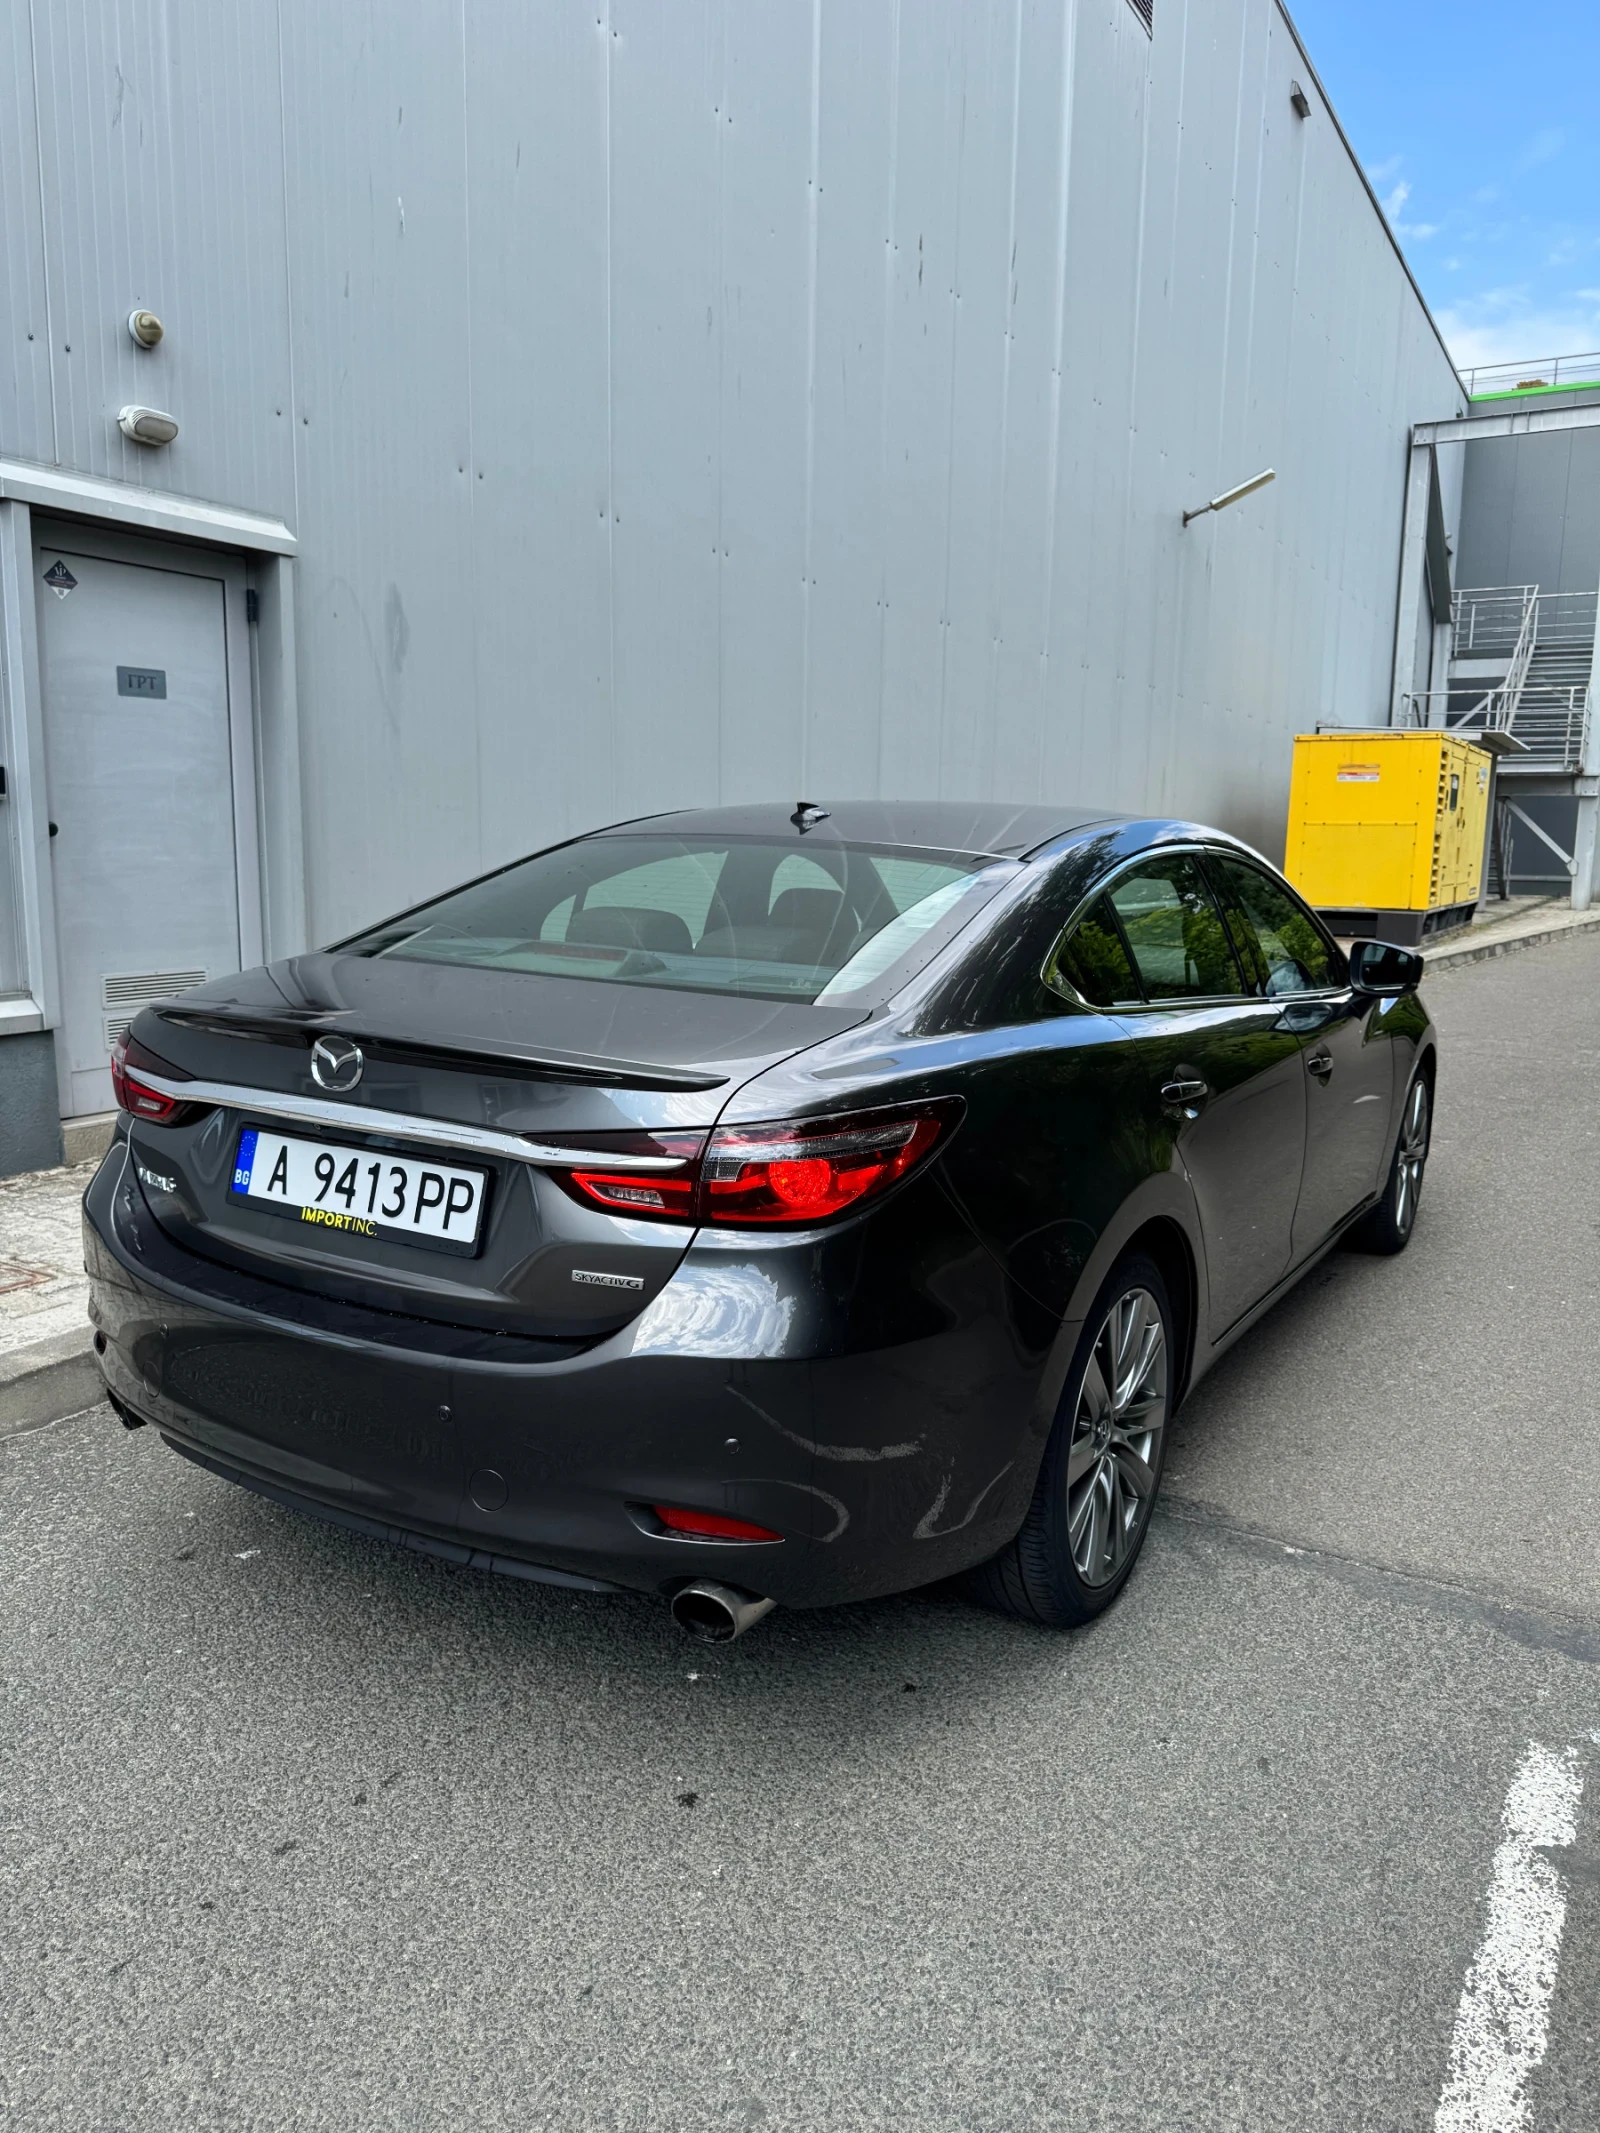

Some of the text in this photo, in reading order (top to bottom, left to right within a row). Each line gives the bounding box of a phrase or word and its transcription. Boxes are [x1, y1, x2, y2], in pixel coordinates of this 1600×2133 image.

[128, 674, 157, 690] ГРТ
[233, 1168, 250, 1186] BG
[267, 1145, 288, 1196] A
